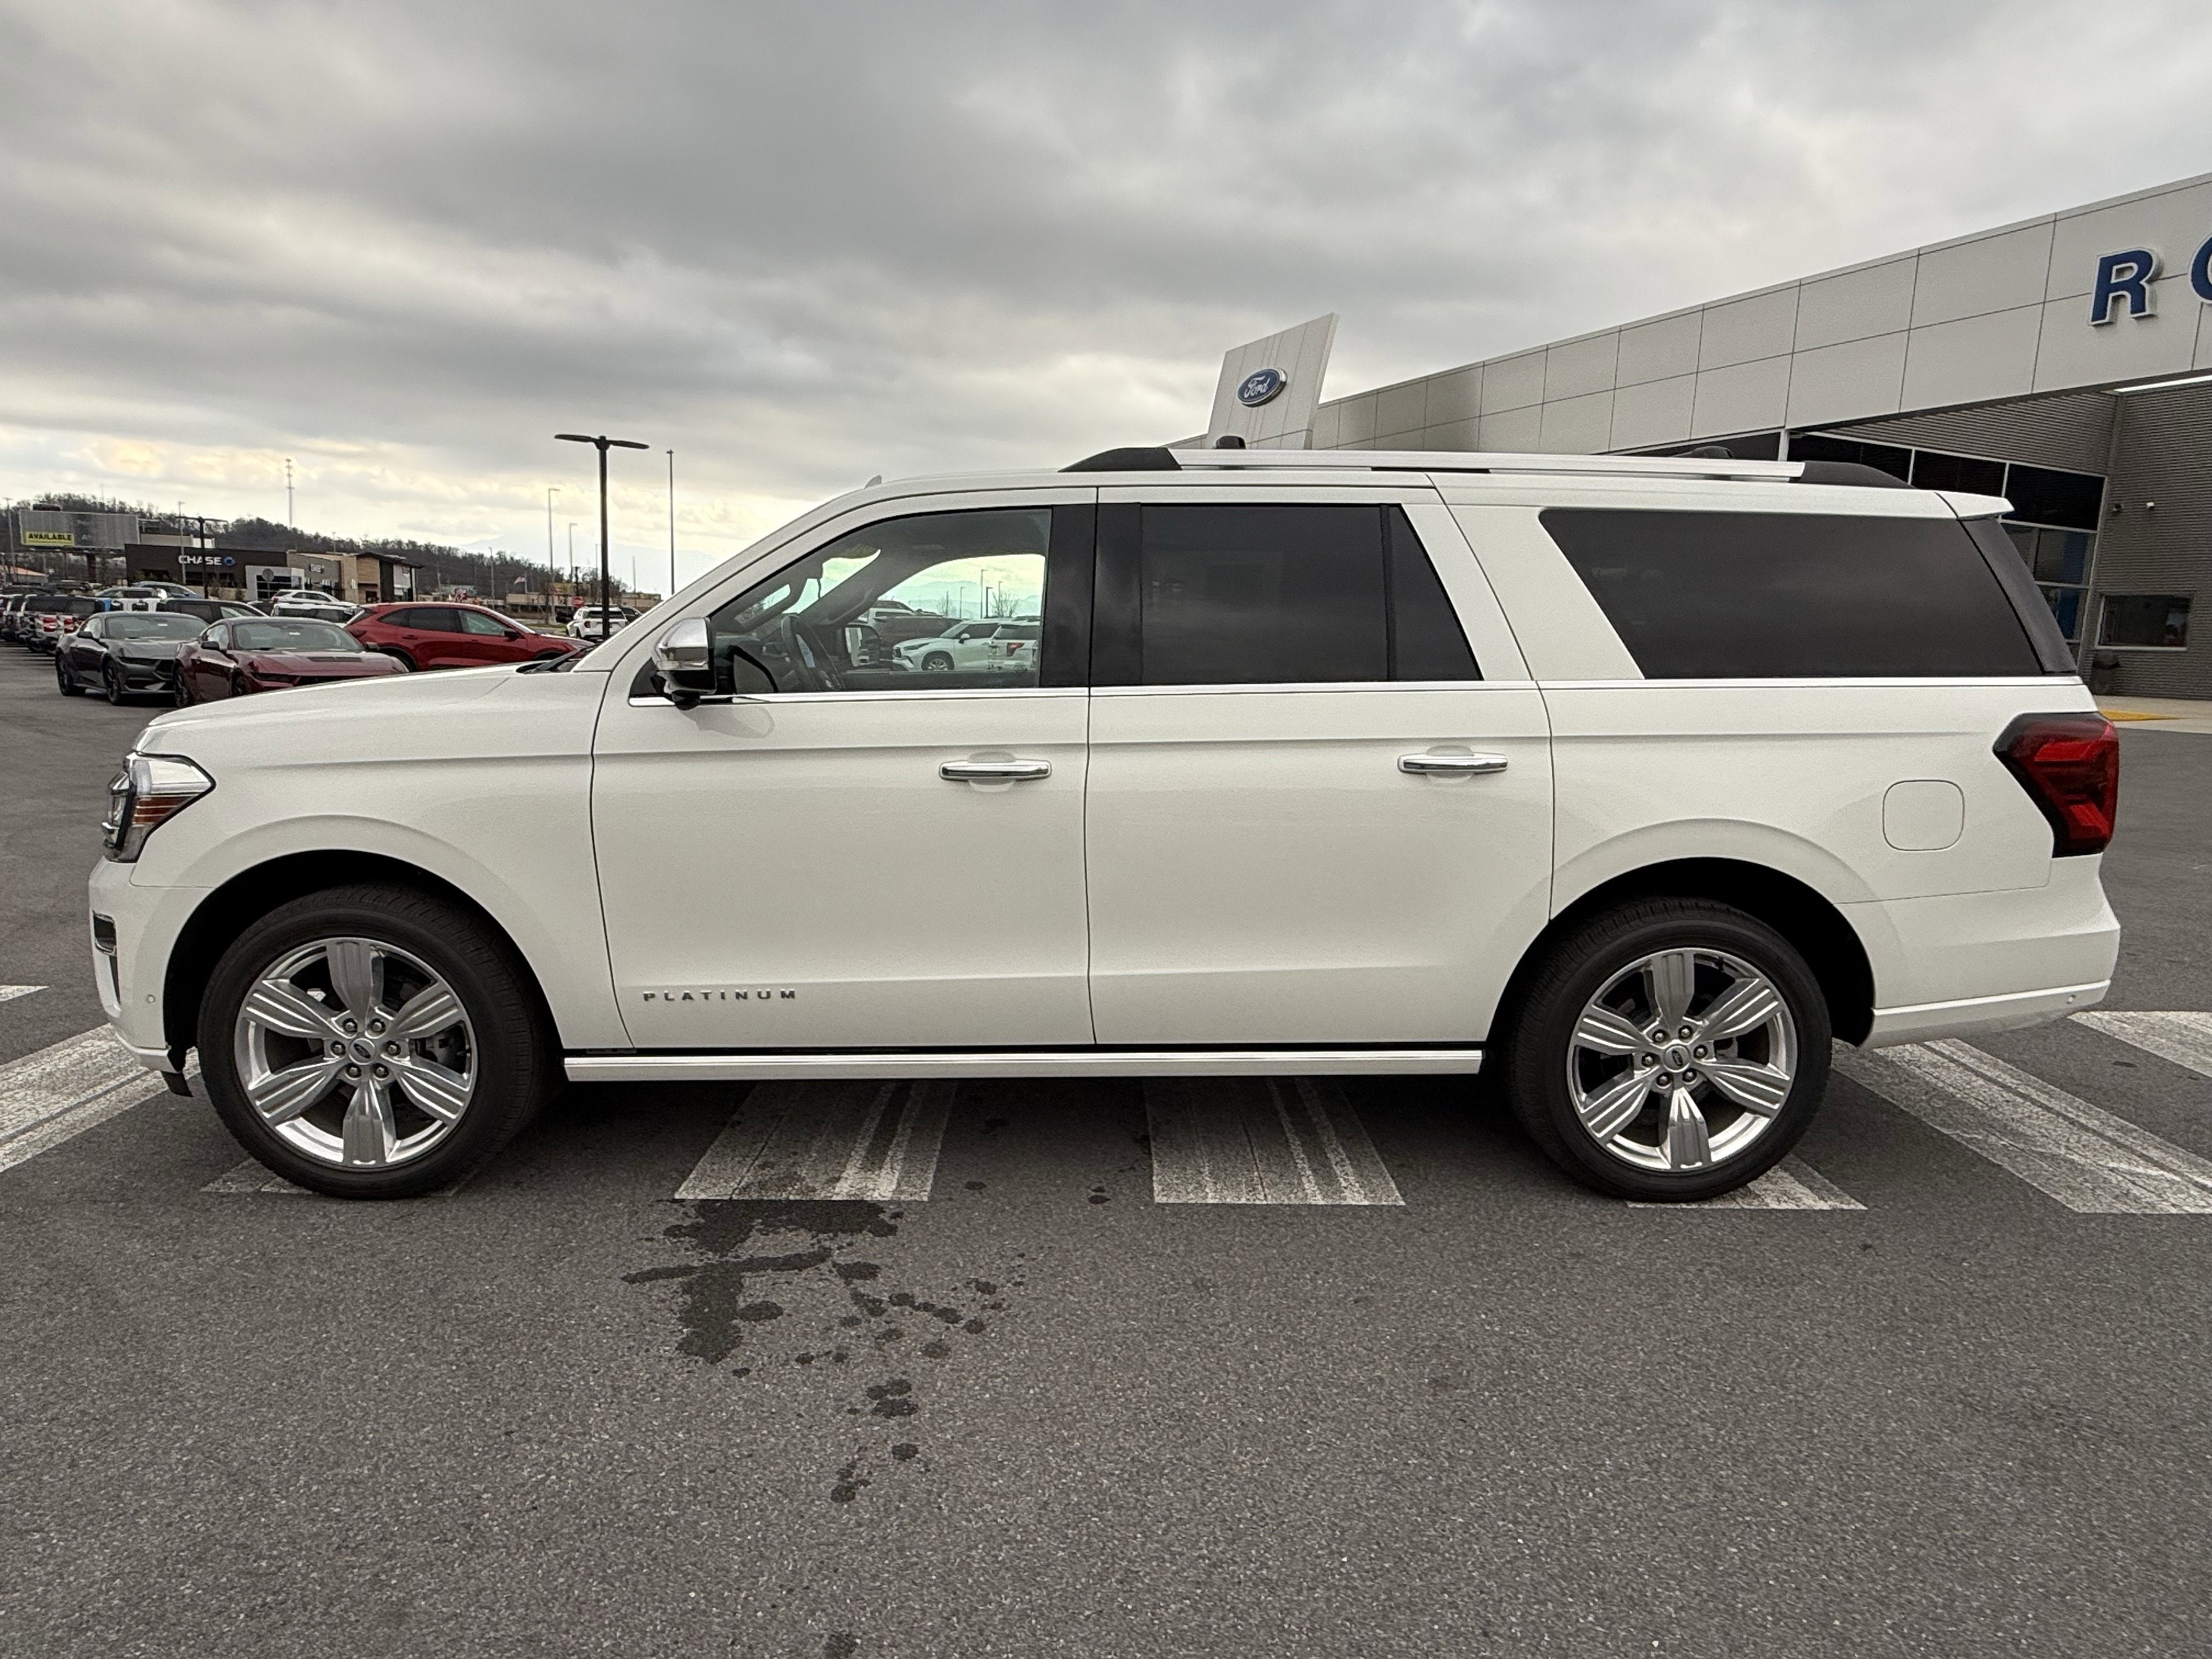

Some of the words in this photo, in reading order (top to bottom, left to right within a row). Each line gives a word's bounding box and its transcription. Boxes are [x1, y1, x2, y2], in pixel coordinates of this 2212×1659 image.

[1244, 375, 1271, 398] Ford
[29, 533, 72, 541] AVAILABLE
[178, 555, 222, 565] CHASE
[643, 989, 795, 1001] PLATINUM
